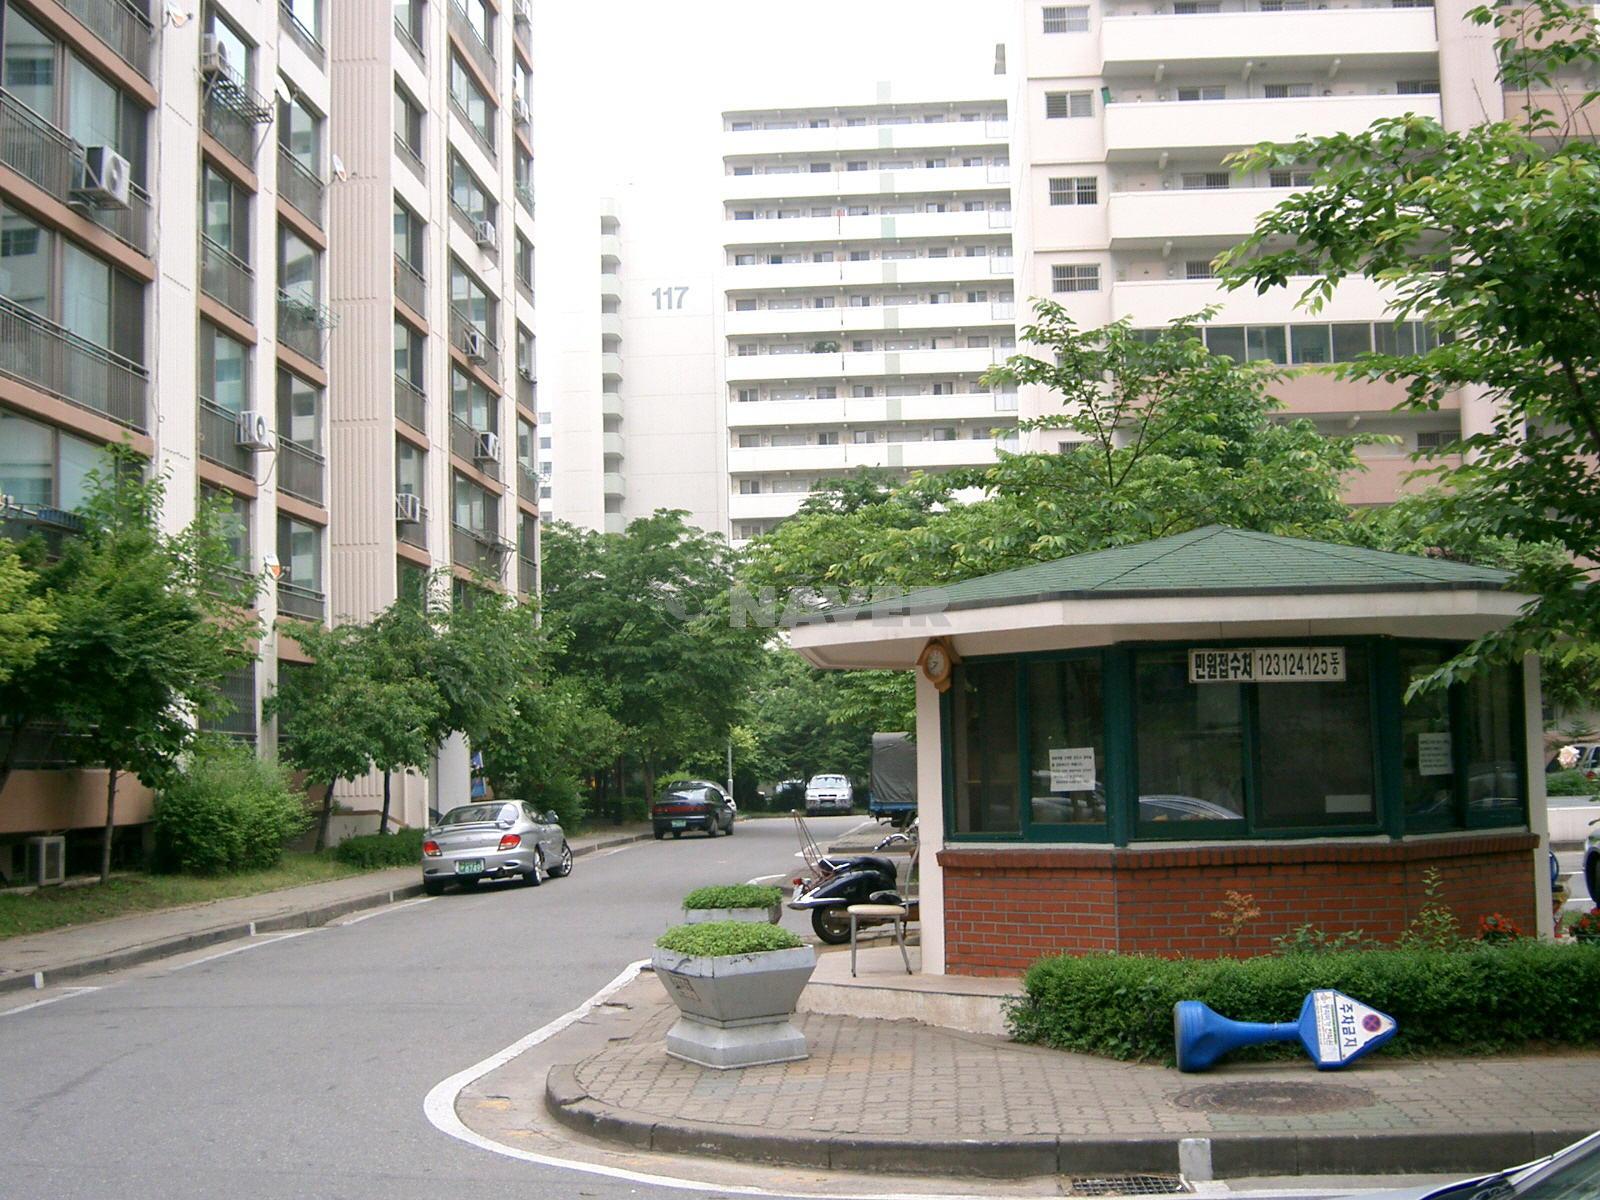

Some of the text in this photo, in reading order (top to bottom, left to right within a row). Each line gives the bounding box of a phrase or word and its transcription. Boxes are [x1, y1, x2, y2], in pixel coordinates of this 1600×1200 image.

[652, 286, 689, 310] 117
[1194, 652, 1253, 680] 민원접수처
[1339, 1003, 1358, 1047] 주차금지
